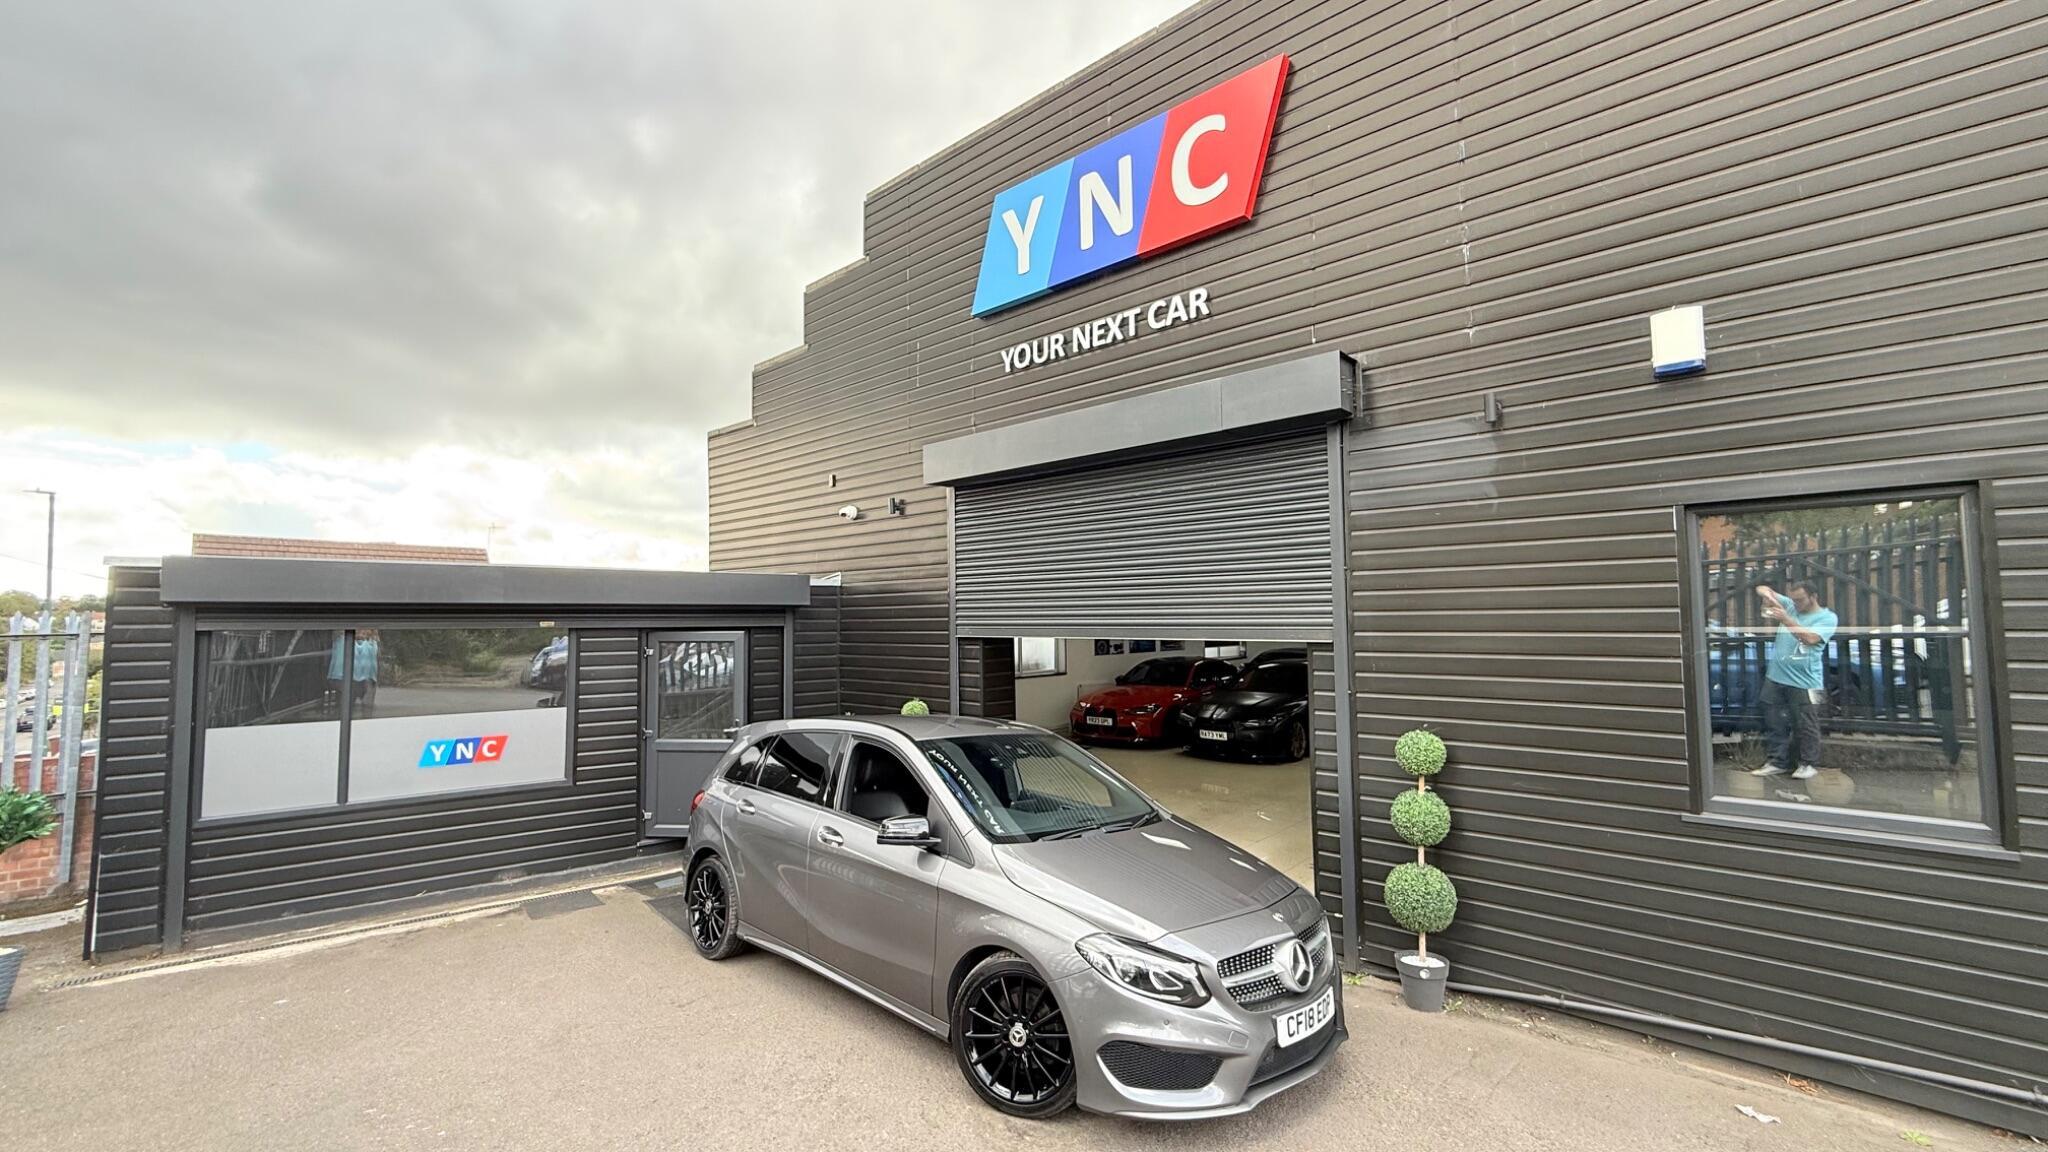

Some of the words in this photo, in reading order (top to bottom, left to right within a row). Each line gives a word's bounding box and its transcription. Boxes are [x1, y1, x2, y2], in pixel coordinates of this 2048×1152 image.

[1002, 114, 1229, 275] YNC
[1001, 333, 1066, 373] YOUR
[1072, 307, 1142, 353] NEXT
[1147, 287, 1210, 329] CAR
[430, 740, 497, 762] YNC
[1286, 1007, 1315, 1038] CF18
